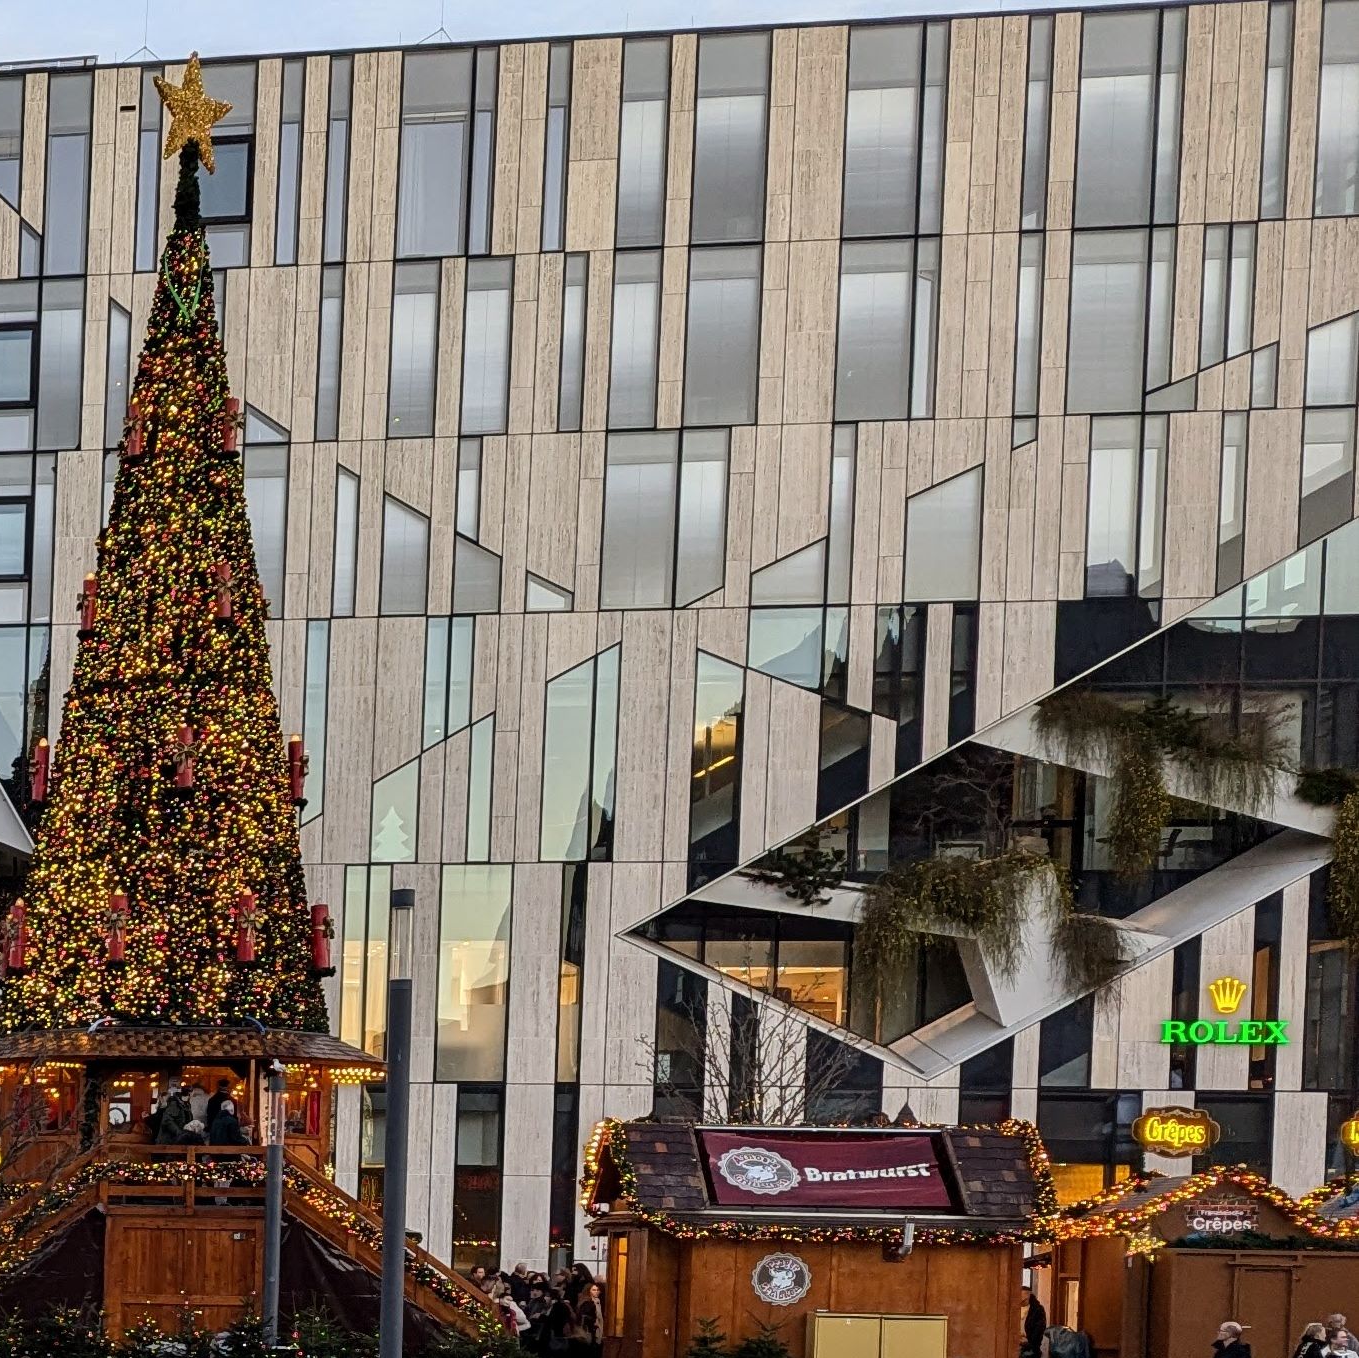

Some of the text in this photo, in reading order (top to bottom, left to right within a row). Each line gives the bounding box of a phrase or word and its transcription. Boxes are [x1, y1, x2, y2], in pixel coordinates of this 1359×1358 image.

[1161, 1020, 1290, 1043] ROLEX
[1146, 1117, 1206, 1146] Crêpes
[803, 1163, 931, 1182] Bratwurst
[1192, 1217, 1252, 1234] Crêpes
